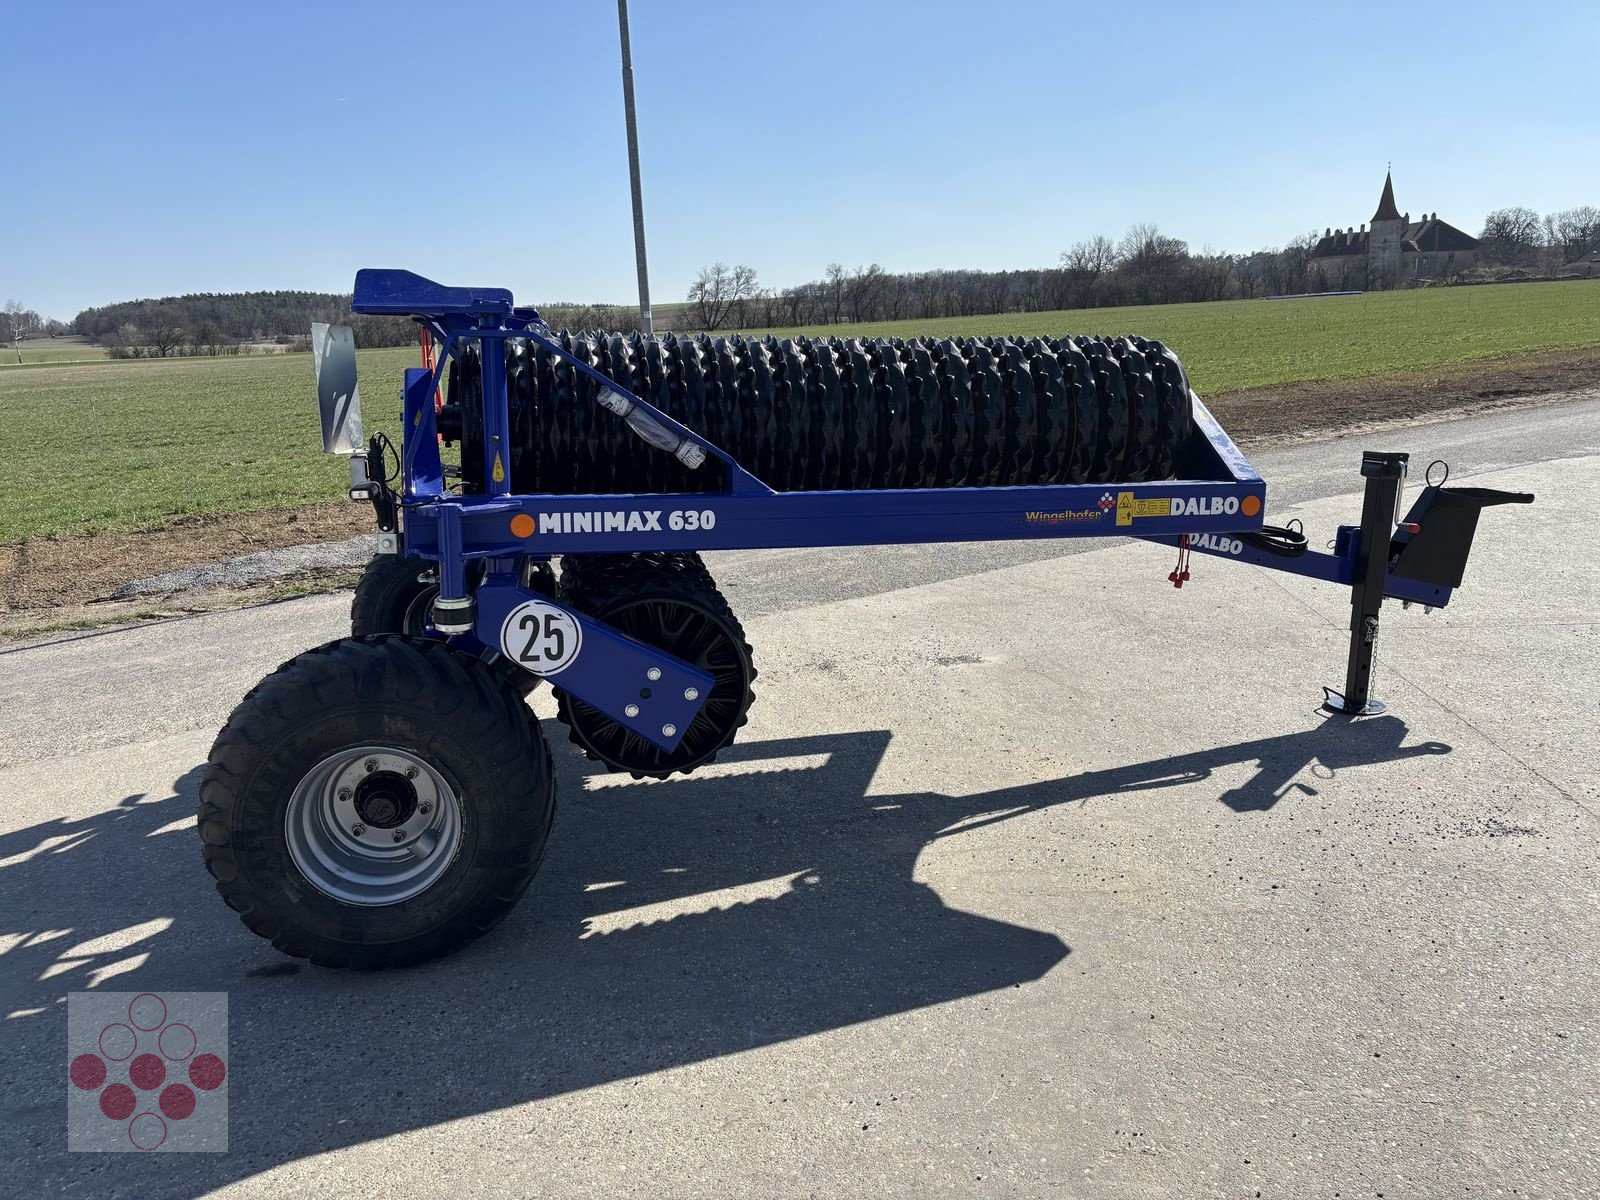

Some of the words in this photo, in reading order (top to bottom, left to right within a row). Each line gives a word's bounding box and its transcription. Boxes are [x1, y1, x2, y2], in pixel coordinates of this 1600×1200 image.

[1171, 496, 1239, 516] DALBO
[539, 510, 662, 534] MINIMAX
[668, 510, 716, 531] 630
[1187, 532, 1243, 555] DALBO
[519, 613, 565, 662] 25
